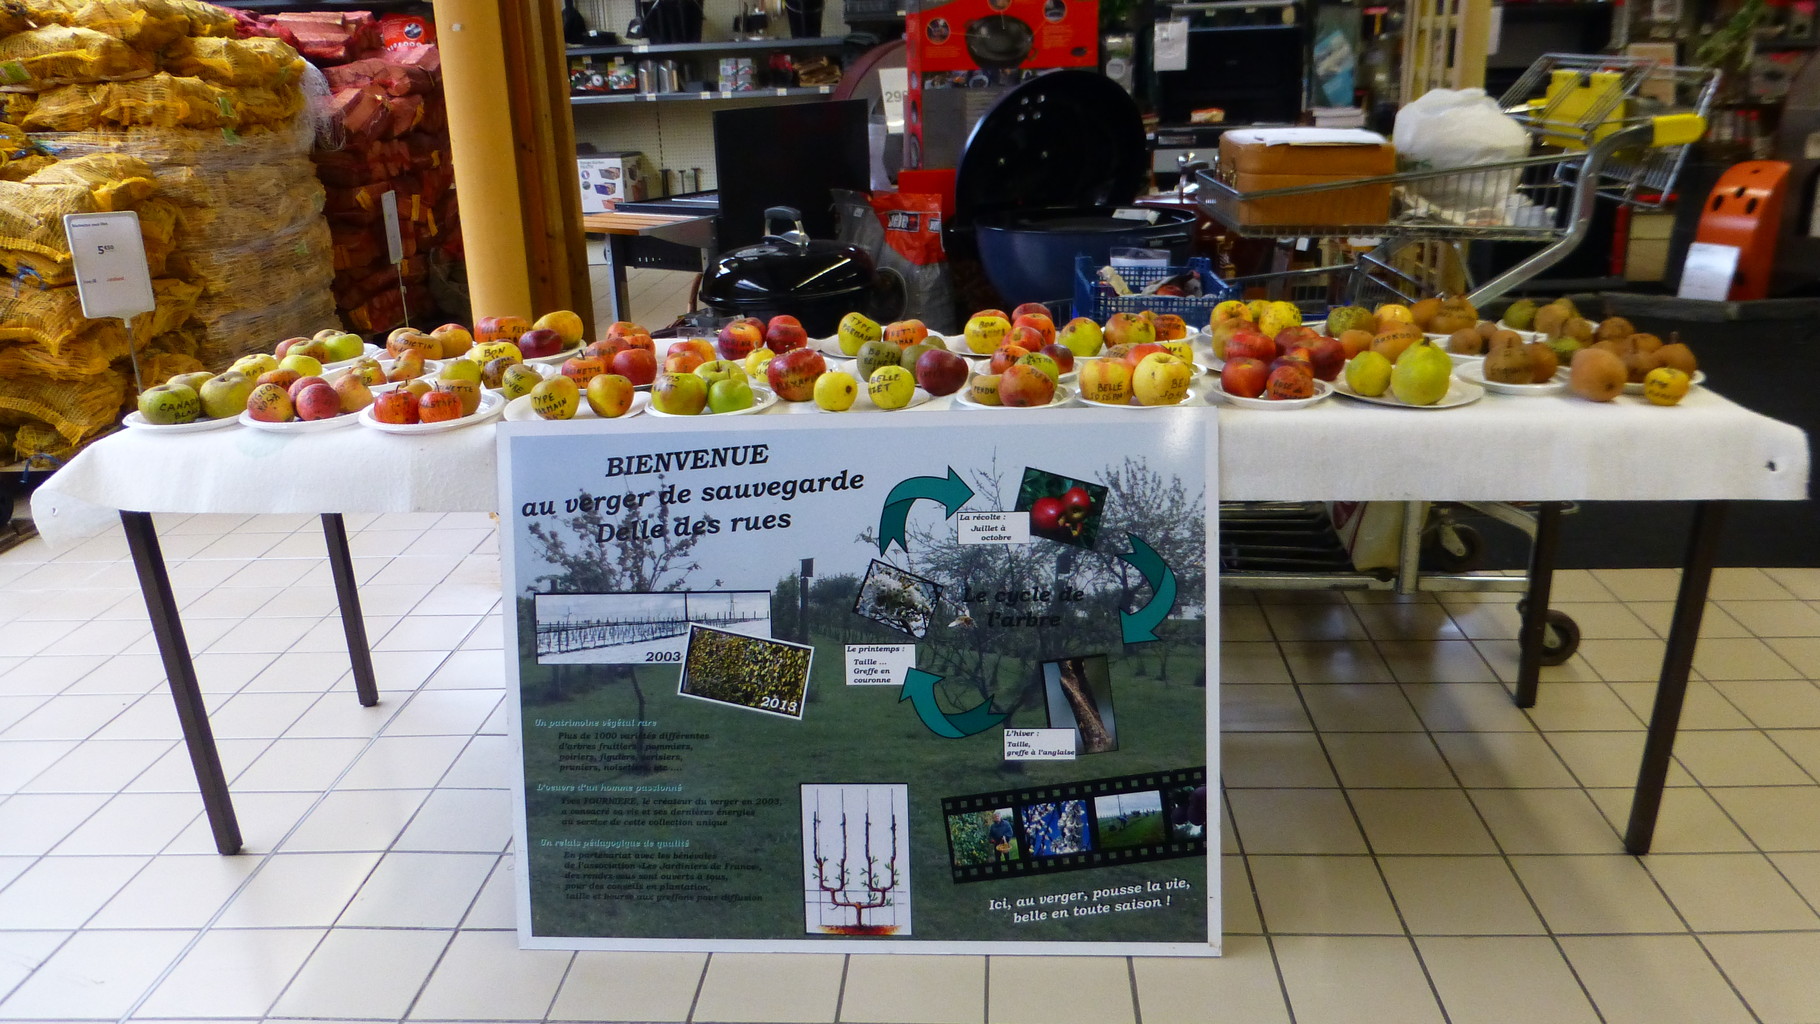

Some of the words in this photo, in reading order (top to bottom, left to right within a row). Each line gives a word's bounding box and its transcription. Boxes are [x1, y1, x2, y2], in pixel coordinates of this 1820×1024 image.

[484, 347, 506, 357] BON
[870, 373, 900, 384] BELLE
[1097, 383, 1123, 392] BELLE
[533, 392, 555, 405] TYPE
[605, 443, 769, 477] BIENVENUE
[522, 500, 556, 517] au
[565, 490, 651, 516] verger
[659, 484, 692, 505] de
[701, 469, 865, 502] sauvegarde
[972, 513, 1001, 521] récolte
[595, 519, 666, 543] Delle
[674, 515, 721, 536] des
[731, 513, 792, 533] rues
[971, 524, 998, 532] Juillet
[1000, 524, 1006, 532] à
[963, 586, 987, 603] Le
[995, 585, 1052, 607] cycle
[1058, 585, 1084, 602] de
[988, 611, 1061, 628] l'arbre
[858, 645, 900, 654] printemps
[645, 651, 682, 662] 2003
[854, 658, 878, 666] Taille
[853, 667, 879, 676] Greffe
[761, 695, 798, 713] 2013
[534, 718, 548, 728] Un
[548, 718, 600, 729] patrimoine
[603, 718, 636, 729] végétal
[637, 720, 657, 728] rare
[559, 732, 577, 740] Plus
[580, 732, 592, 740] de
[595, 732, 618, 740] 1000
[659, 731, 711, 742] différentes
[559, 742, 597, 751] d'arbres
[597, 742, 637, 752] fruitiers
[644, 742, 693, 752] pommiers,
[1006, 749, 1029, 757] greffe
[1038, 748, 1075, 757] l'anglaise
[600, 783, 634, 792] homme
[635, 783, 684, 793] passionné
[989, 897, 1012, 911] Ici,
[1015, 898, 1036, 908] au
[1038, 890, 1089, 904] verger,
[1092, 884, 1143, 901] pousse
[1146, 881, 1162, 892] la
[1165, 877, 1191, 890] vie,
[1013, 911, 1048, 925] belle
[1051, 909, 1069, 919] en
[1073, 904, 1111, 917] toute
[1114, 898, 1162, 912] saison
